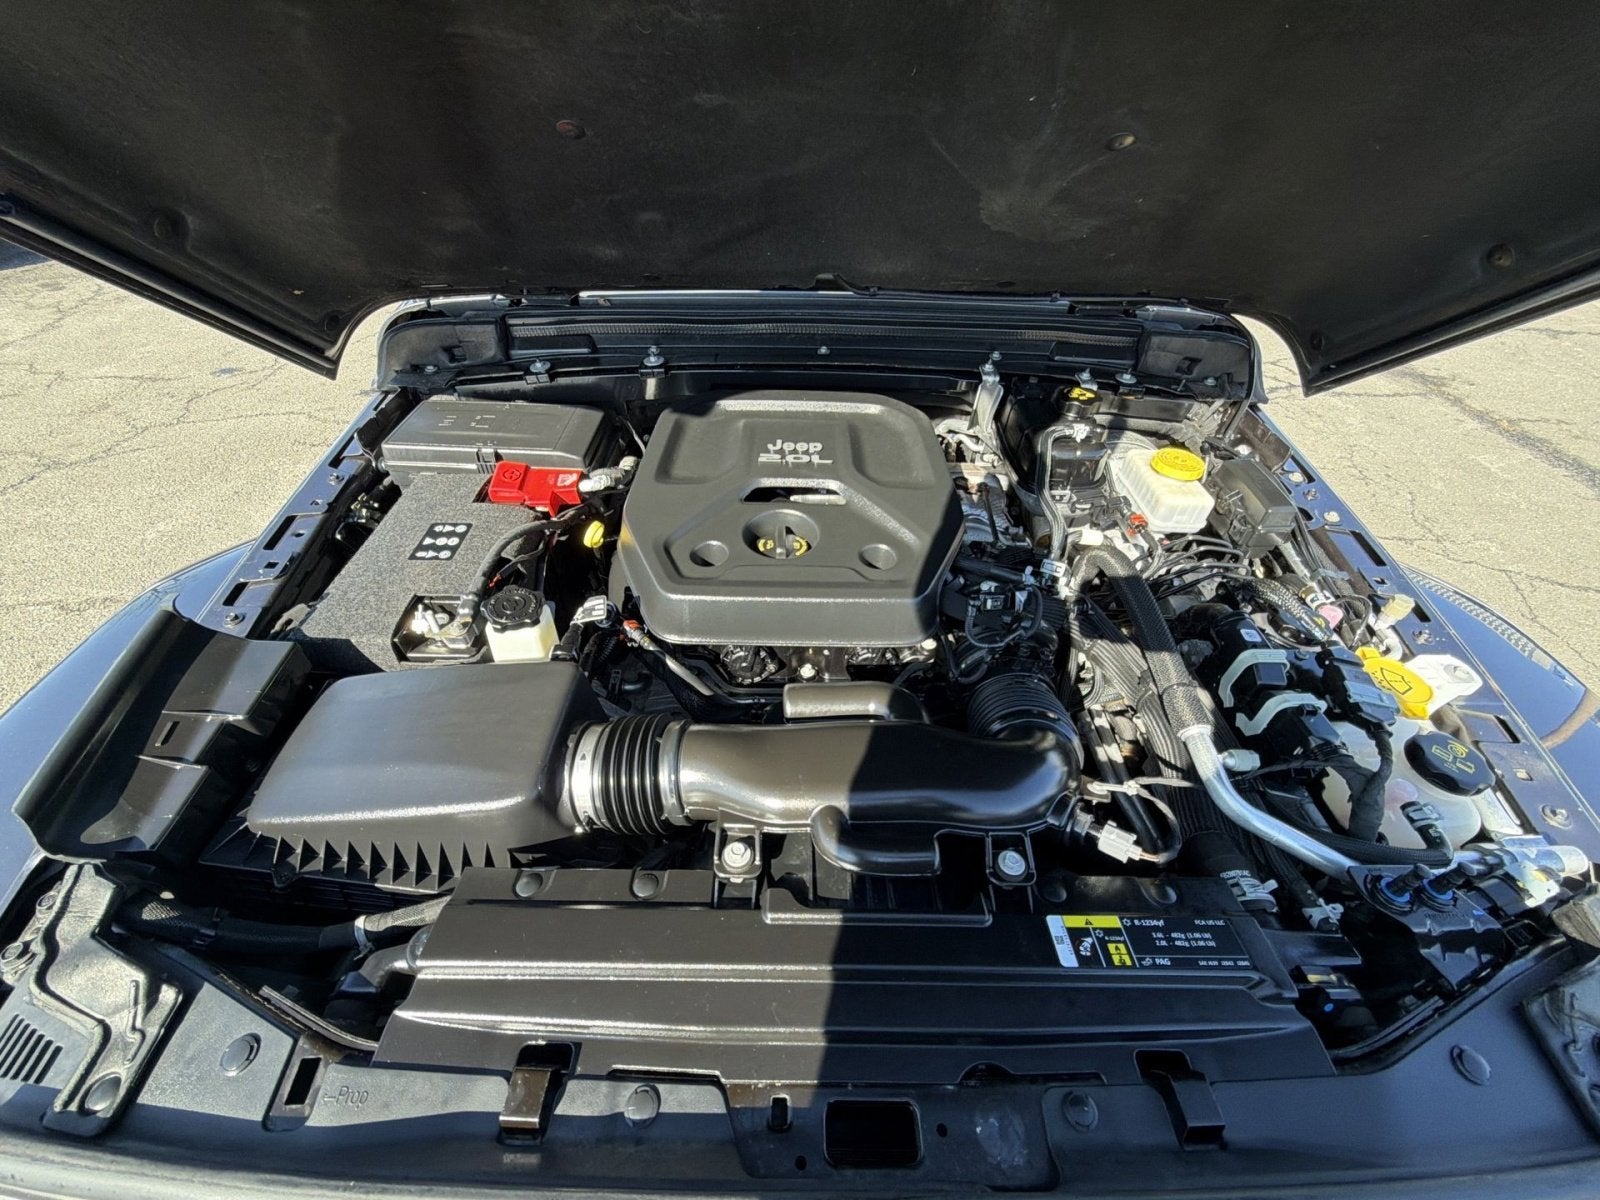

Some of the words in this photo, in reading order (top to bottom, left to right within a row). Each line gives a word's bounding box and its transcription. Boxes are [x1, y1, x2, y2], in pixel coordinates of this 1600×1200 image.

[767, 439, 823, 453] Jeep
[758, 453, 833, 465] 2.0L
[1134, 919, 1165, 927] R-1234yf
[1155, 958, 1171, 966] PAG
